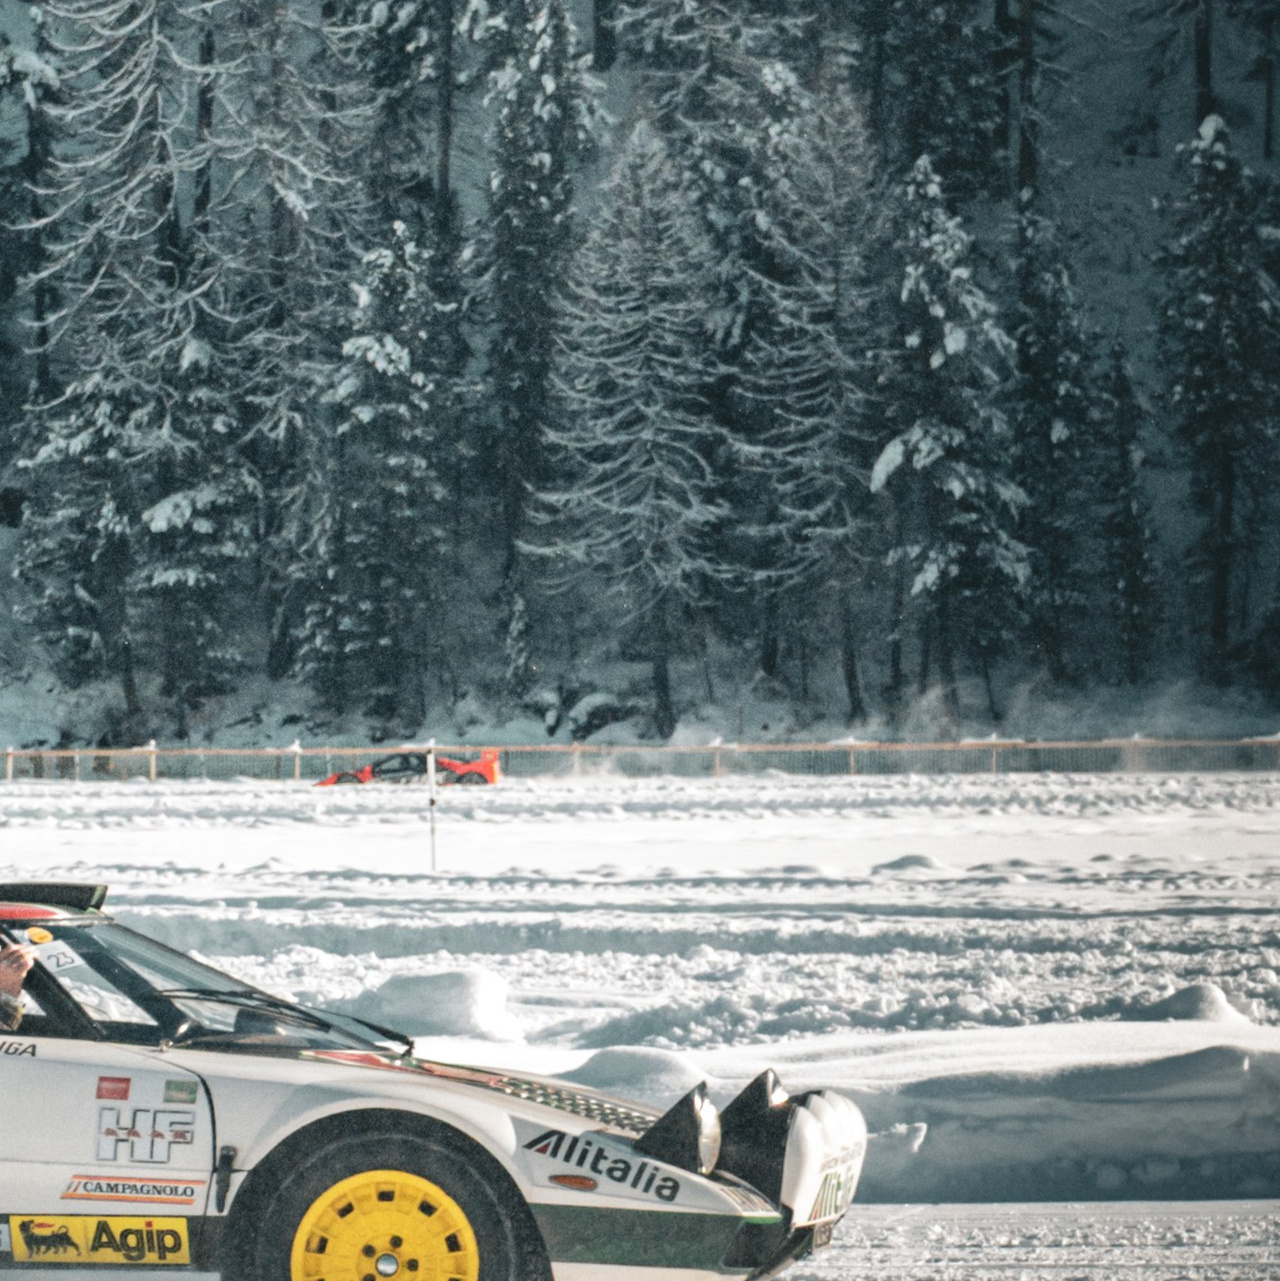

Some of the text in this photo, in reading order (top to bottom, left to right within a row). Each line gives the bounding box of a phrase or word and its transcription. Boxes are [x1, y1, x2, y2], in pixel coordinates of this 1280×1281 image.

[47, 951, 76, 969] 23
[523, 1129, 681, 1203] Alitalia
[83, 1180, 195, 1198] CAMPAGNOLO
[90, 1220, 183, 1261] Agip
